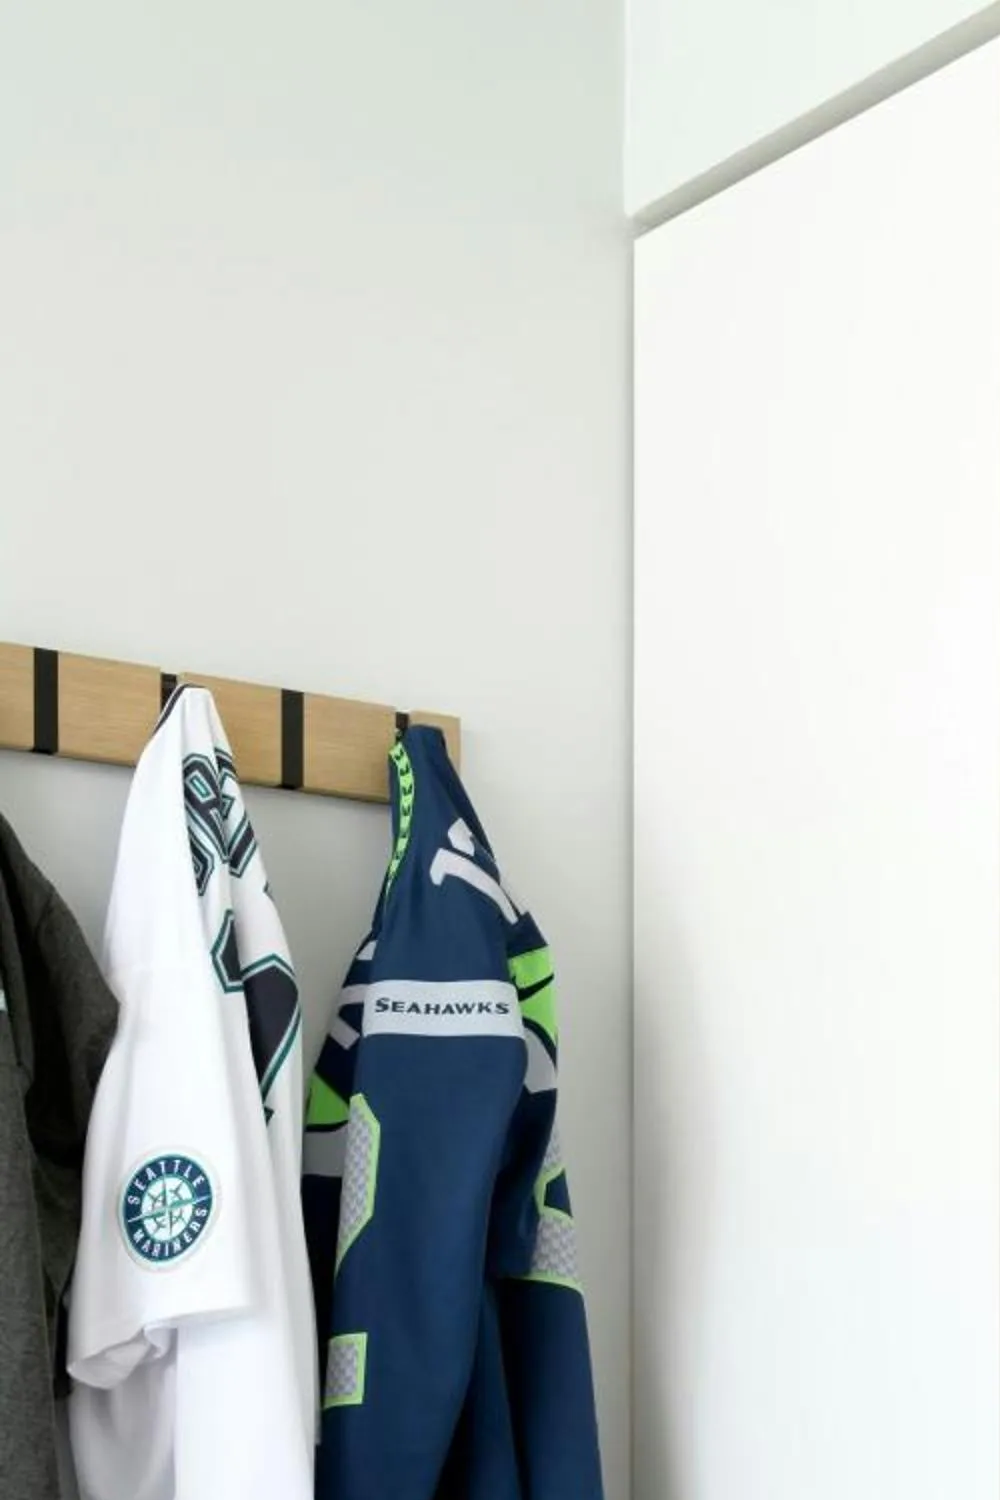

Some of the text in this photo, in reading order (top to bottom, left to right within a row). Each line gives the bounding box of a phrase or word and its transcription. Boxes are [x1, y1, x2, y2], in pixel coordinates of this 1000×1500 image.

[375, 997, 510, 1015] SEAHAWKS
[127, 1159, 205, 1206] SEATTLE
[132, 1207, 208, 1257] MARINERS
